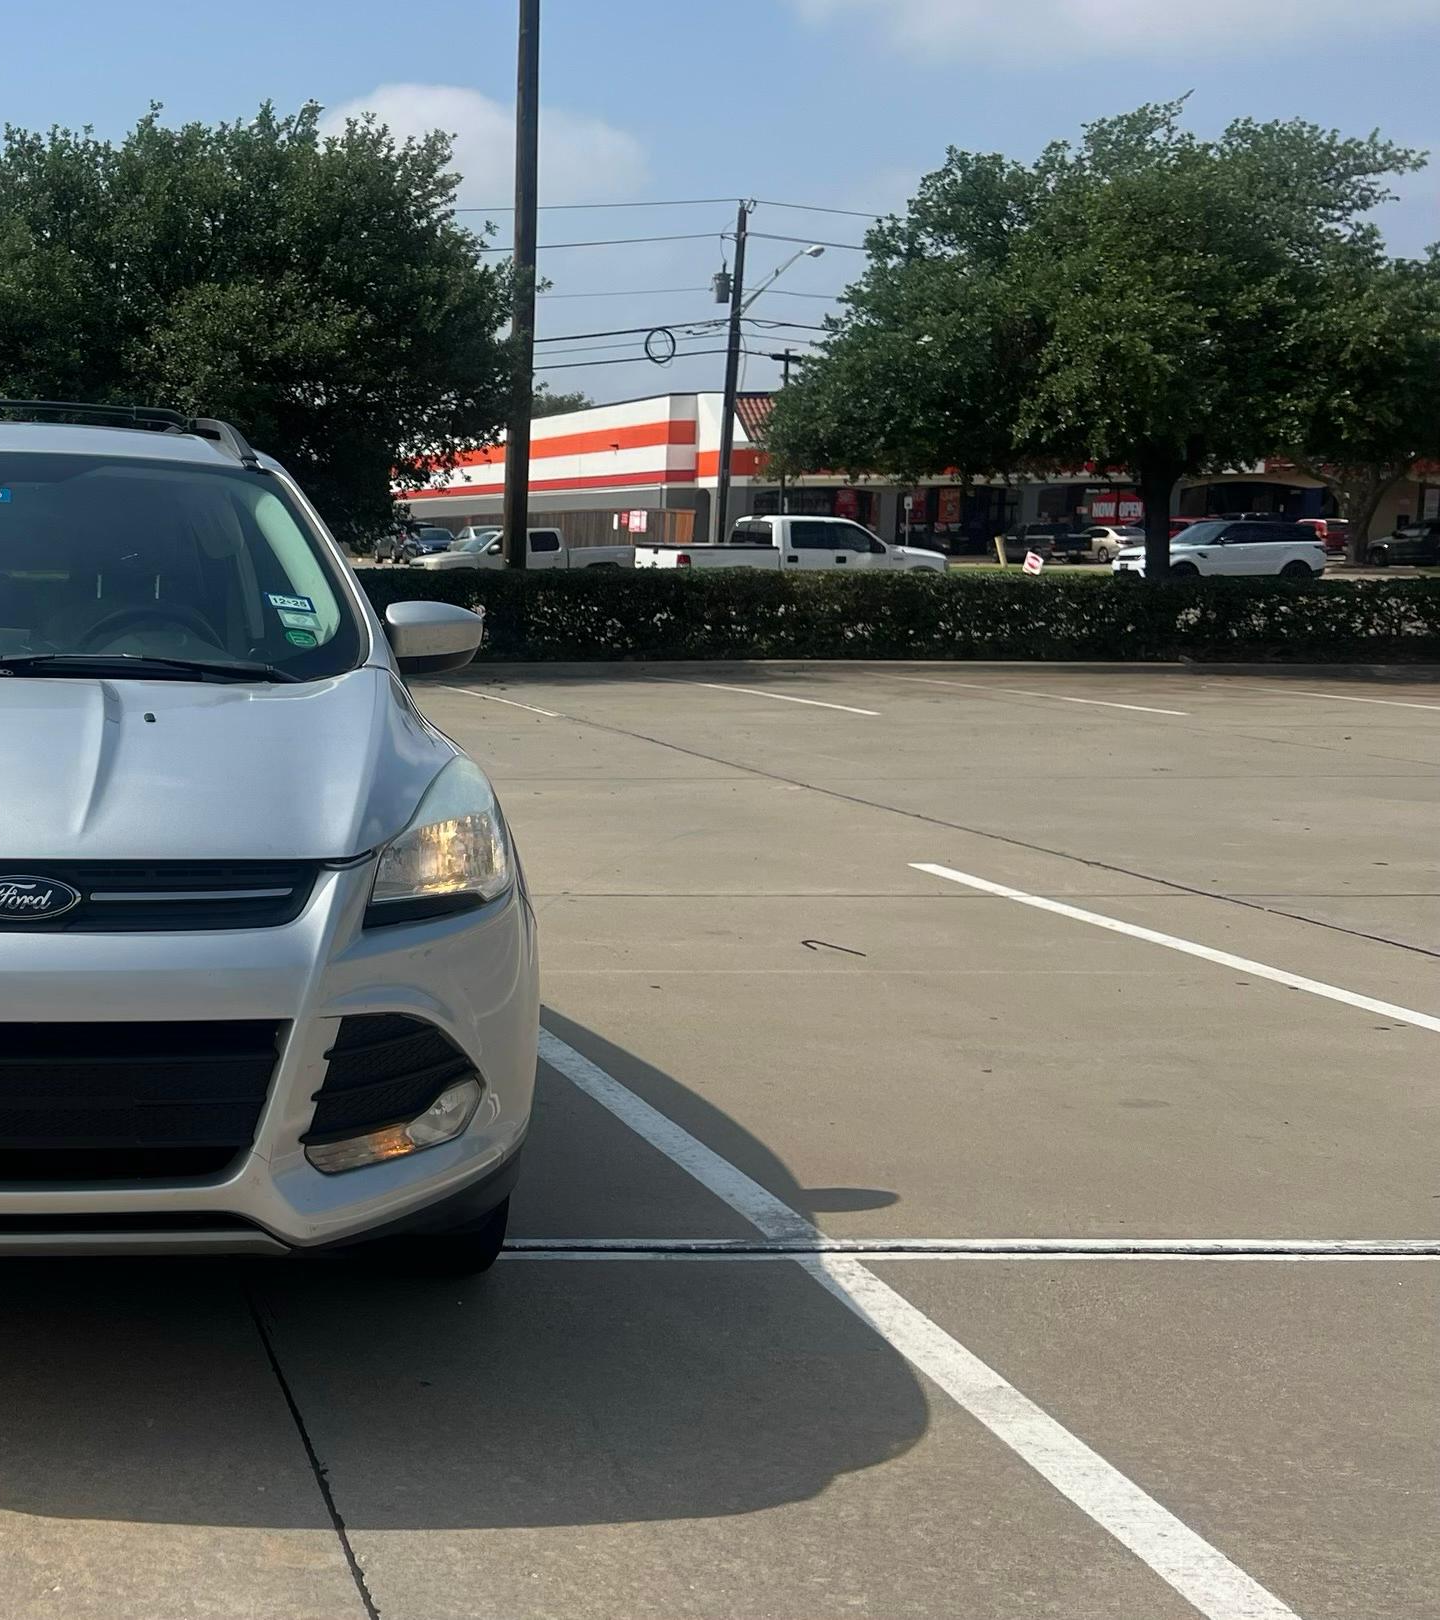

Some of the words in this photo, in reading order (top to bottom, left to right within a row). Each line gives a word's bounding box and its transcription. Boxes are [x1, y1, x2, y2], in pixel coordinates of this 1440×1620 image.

[1092, 502, 1116, 517] NOW
[1119, 501, 1144, 517] OPEN
[272, 597, 307, 608] 12-25
